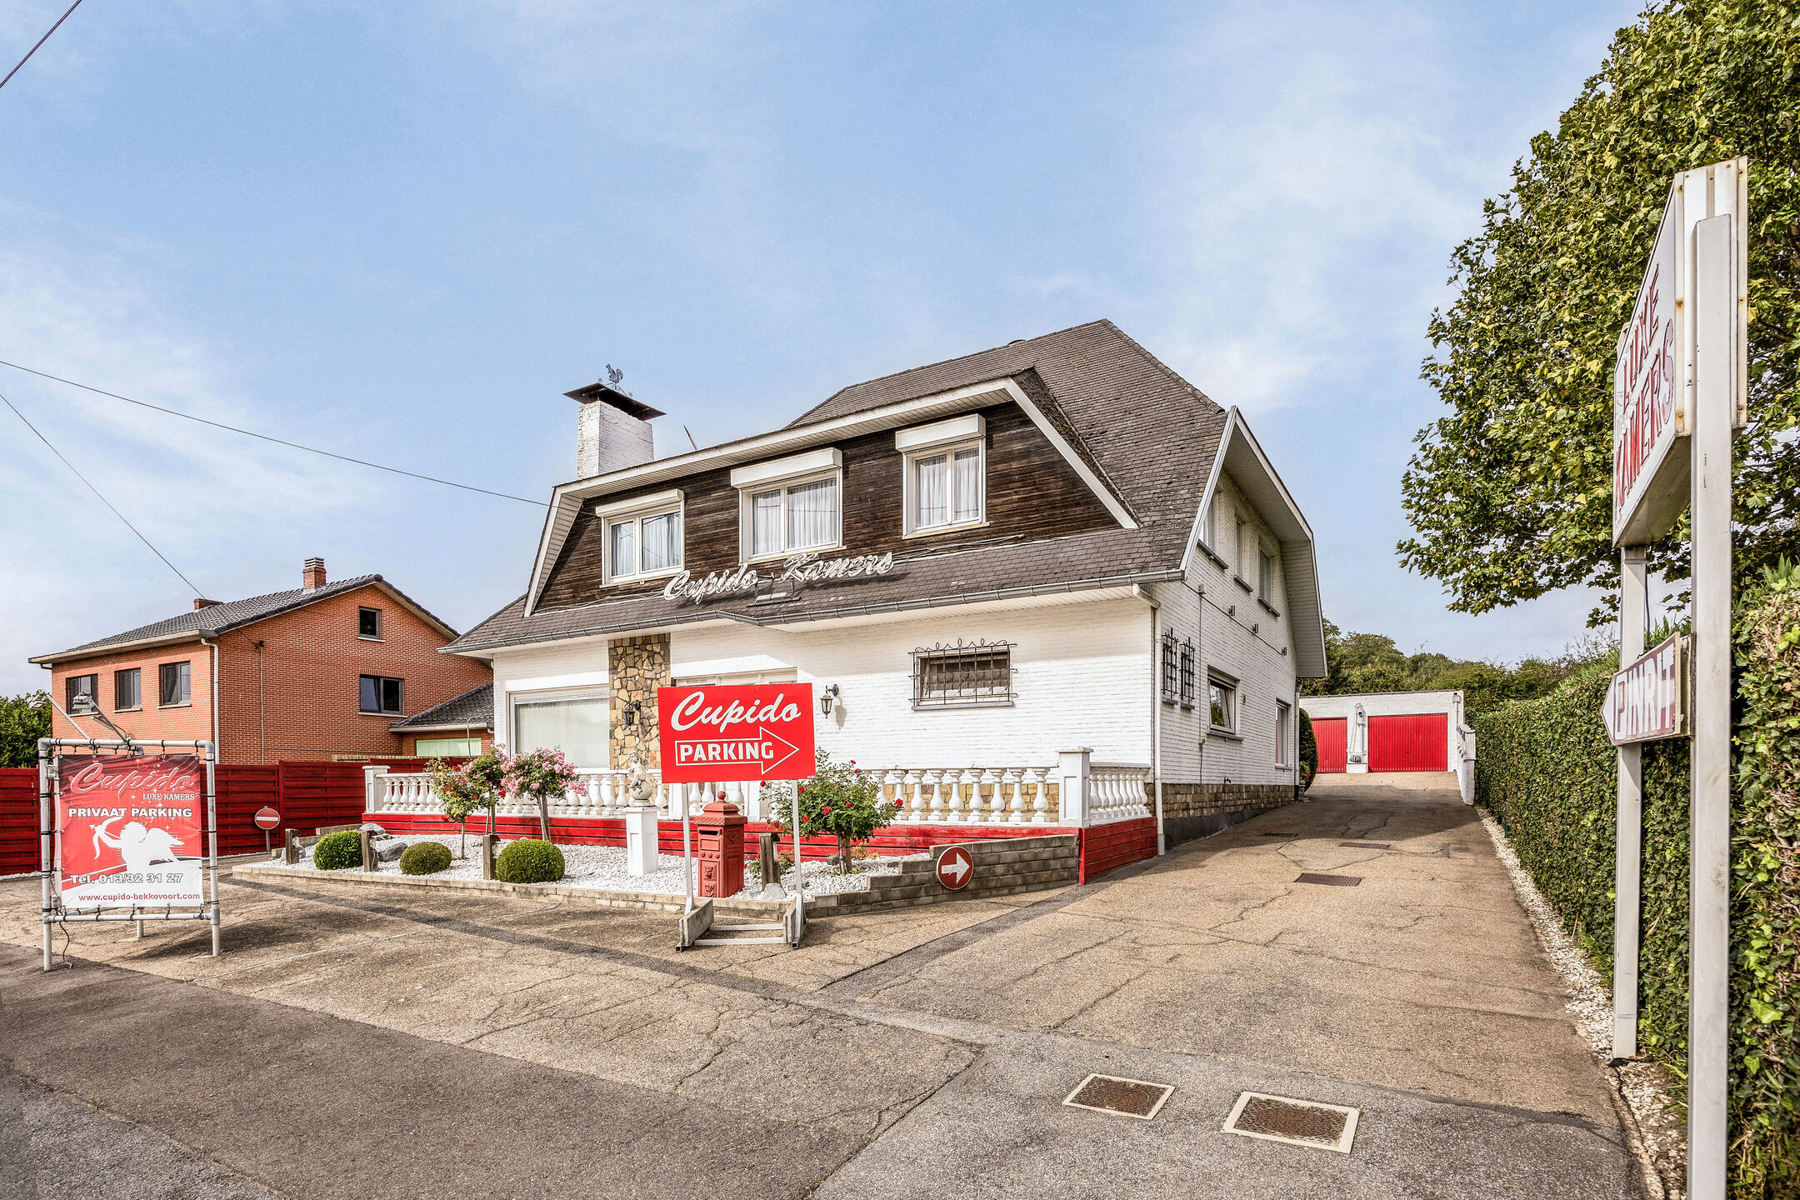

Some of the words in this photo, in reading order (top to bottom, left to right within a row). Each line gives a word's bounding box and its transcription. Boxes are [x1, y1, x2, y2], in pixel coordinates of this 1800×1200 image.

[1623, 262, 1659, 414] LUXE
[1615, 318, 1674, 523] KAMERS
[663, 562, 758, 605] Cupido
[778, 552, 894, 582] Kamers
[1627, 642, 1675, 736] INRIT
[670, 691, 802, 733] Cupido
[679, 741, 774, 762] PARKING
[70, 762, 195, 799] Cupido
[142, 792, 161, 801] LUXE
[163, 791, 195, 801] KAMERS
[68, 807, 128, 818] PRIVAAT
[131, 807, 193, 818] PARKING
[69, 873, 95, 884] Tel.
[98, 873, 144, 884] 013/32
[146, 873, 163, 884] 31
[166, 873, 184, 884] 27
[78, 892, 201, 902] www.cupido-bekkevoort.com
